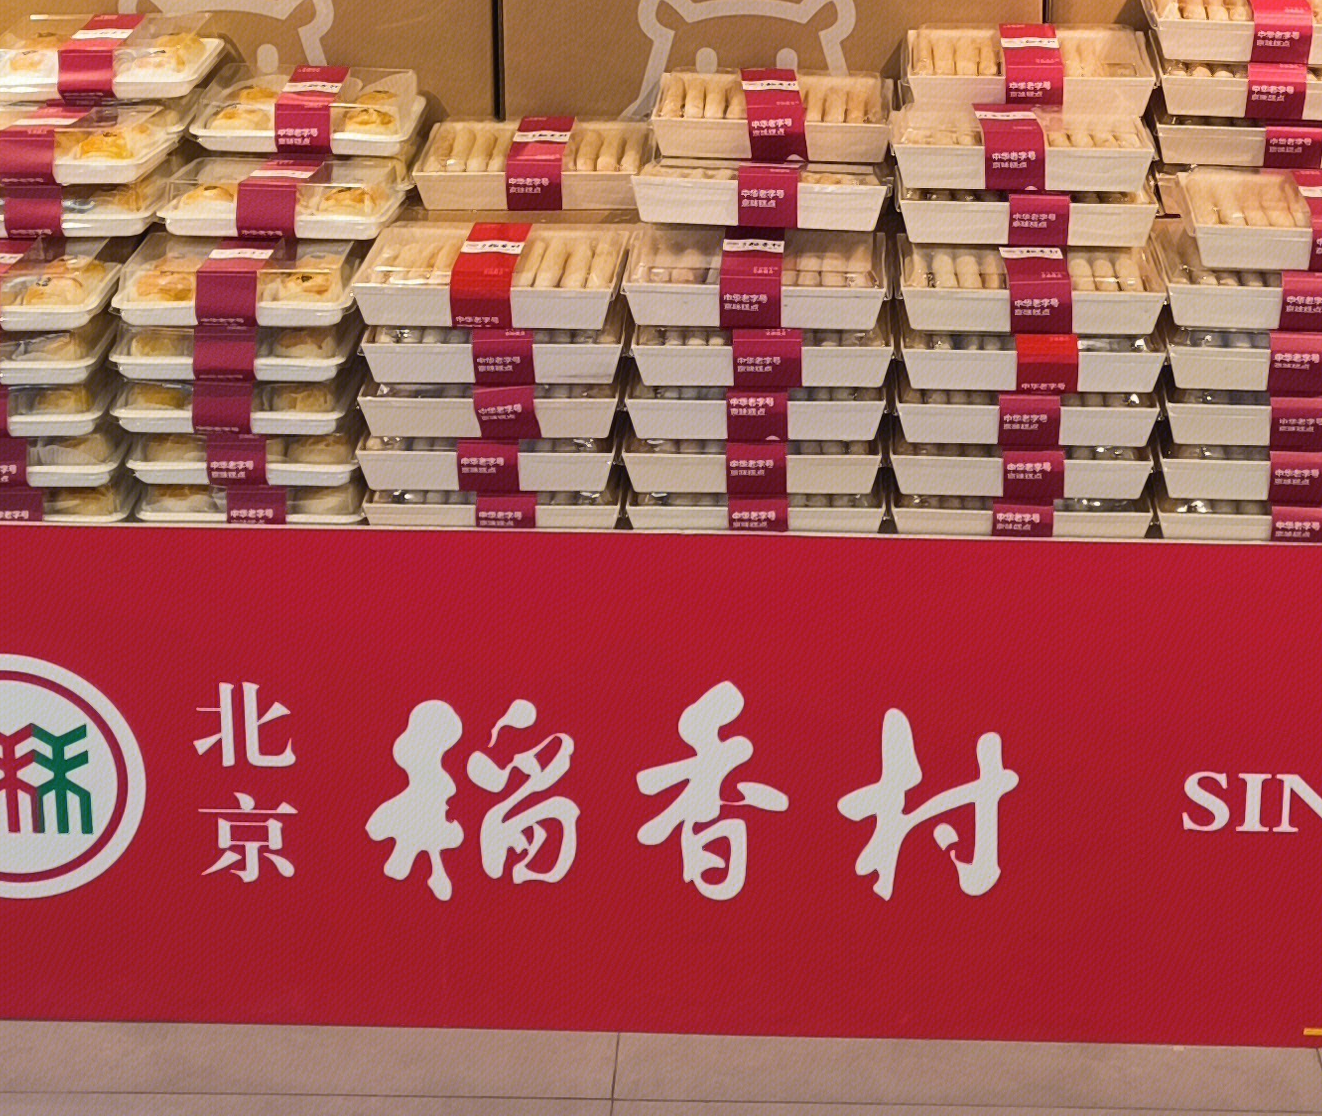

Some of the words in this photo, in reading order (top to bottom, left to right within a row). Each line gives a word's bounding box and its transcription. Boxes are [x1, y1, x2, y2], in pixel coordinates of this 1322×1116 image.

[192, 681, 298, 884] 北京
[364, 680, 1020, 902] 稻香村
